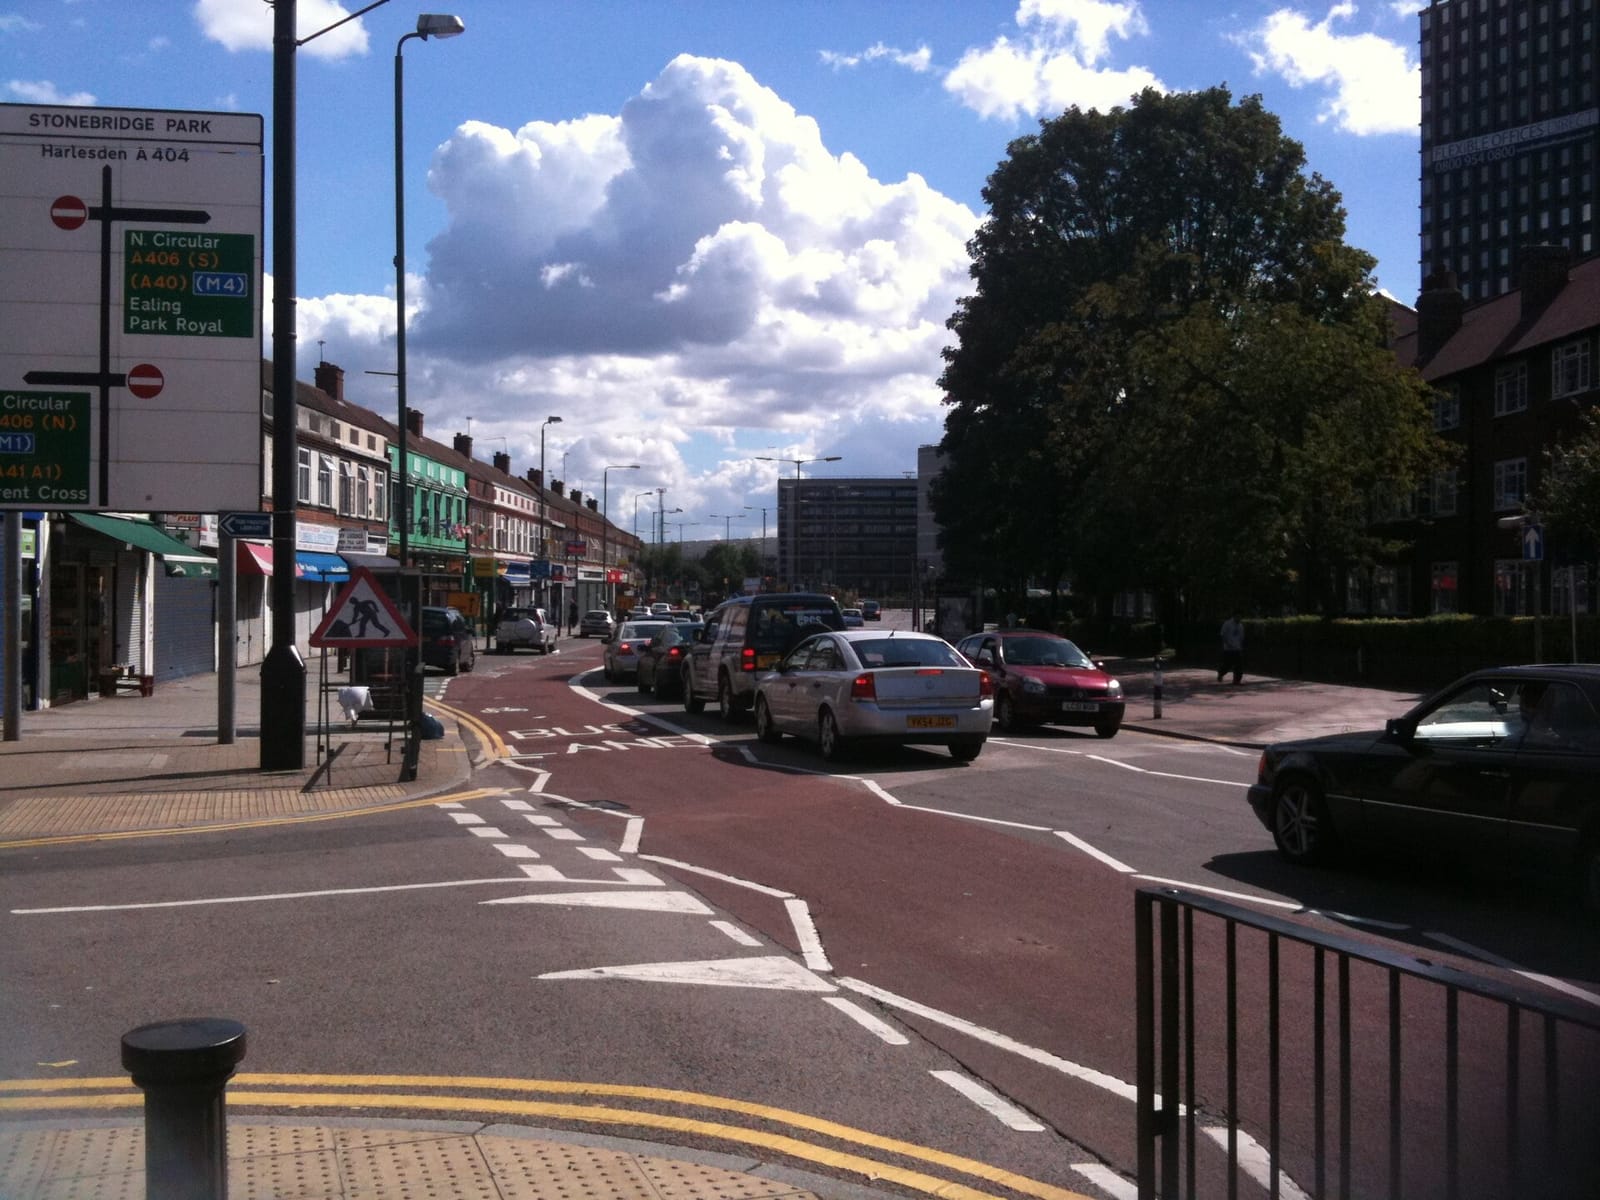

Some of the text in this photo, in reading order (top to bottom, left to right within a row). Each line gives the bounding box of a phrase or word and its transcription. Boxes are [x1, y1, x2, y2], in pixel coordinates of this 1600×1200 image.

[29, 113, 211, 134] STONEBRIDGE PARK
[1492, 125, 1544, 147] OFFICES
[41, 143, 127, 161] Harlesden
[153, 232, 220, 248] Circular
[131, 250, 219, 269] A406 (S)
[131, 273, 245, 293] (A40) (M4)
[130, 297, 181, 315] Ealing
[130, 316, 223, 335] Park Royal
[3, 395, 72, 411] Circular
[42, 414, 77, 431] (N)
[32, 464, 63, 481] A1)
[0, 484, 88, 500] ent Cross
[507, 722, 649, 740] BUS
[504, 735, 710, 756] LANE
